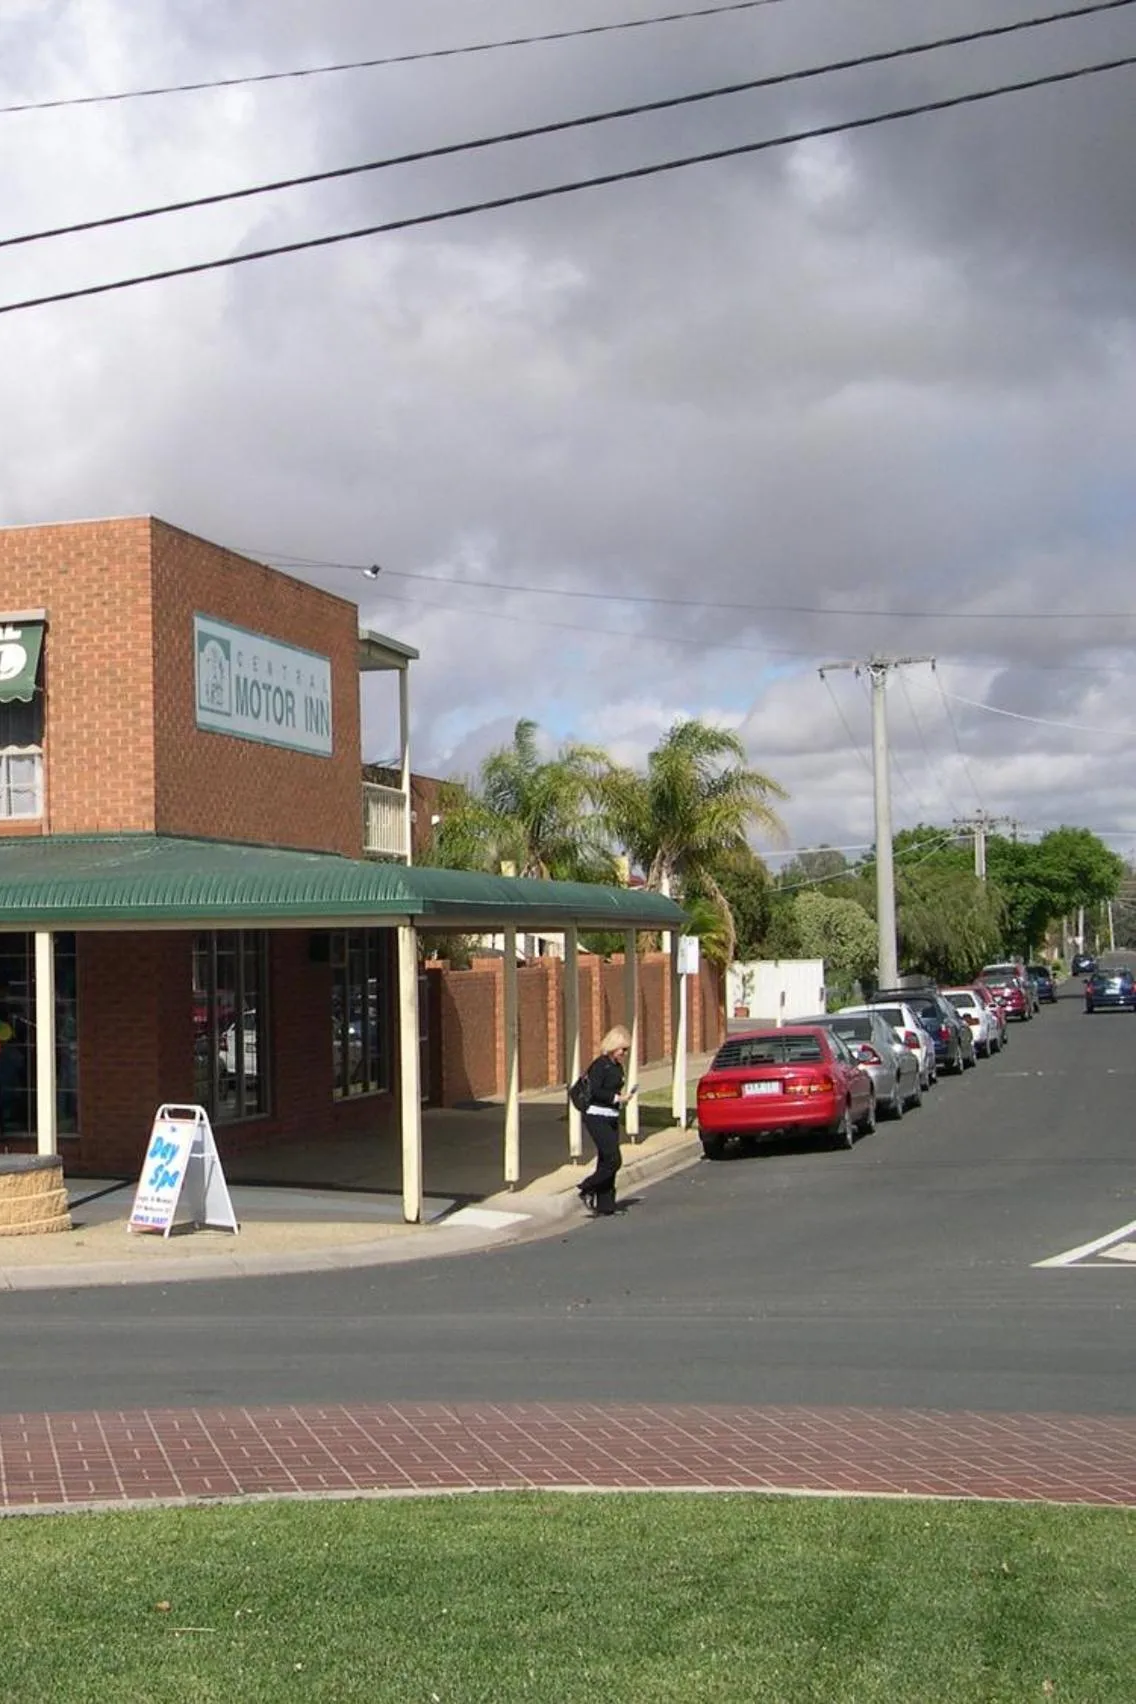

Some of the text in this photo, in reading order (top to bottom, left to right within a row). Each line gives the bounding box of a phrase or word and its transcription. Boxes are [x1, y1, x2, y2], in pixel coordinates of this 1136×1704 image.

[237, 650, 329, 695] CENTRAL
[235, 673, 330, 737] MOTOR INN
